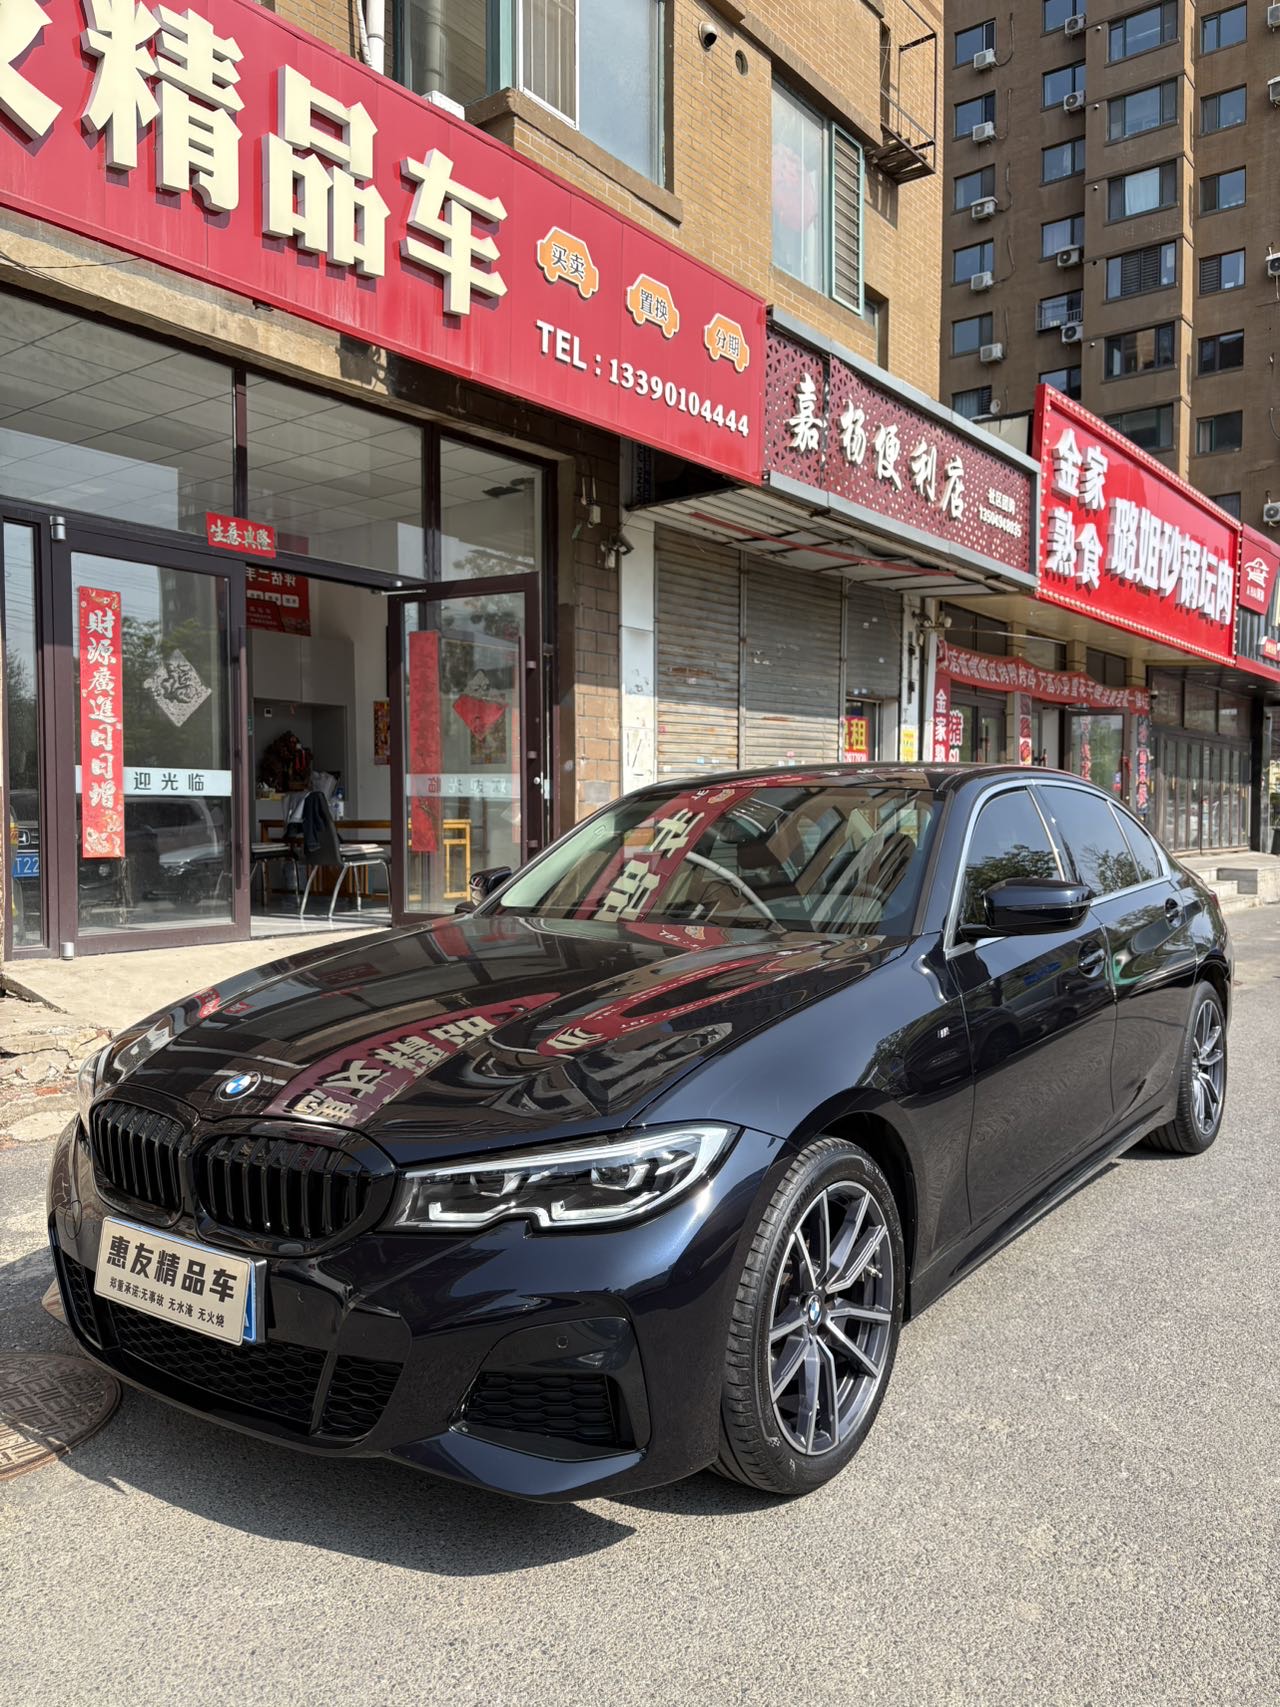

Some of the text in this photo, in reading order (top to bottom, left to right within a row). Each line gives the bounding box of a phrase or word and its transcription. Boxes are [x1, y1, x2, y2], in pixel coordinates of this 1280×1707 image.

[551, 242, 585, 280] 买卖
[640, 288, 669, 323] 置换
[715, 328, 740, 358] 分期
[608, 357, 749, 437] 13390104444
[1051, 428, 1109, 511] 金家
[1045, 506, 1104, 591] 熟食
[106, 1234, 238, 1304] 惠友精品车
[197, 1307, 225, 1328] 无火烧
